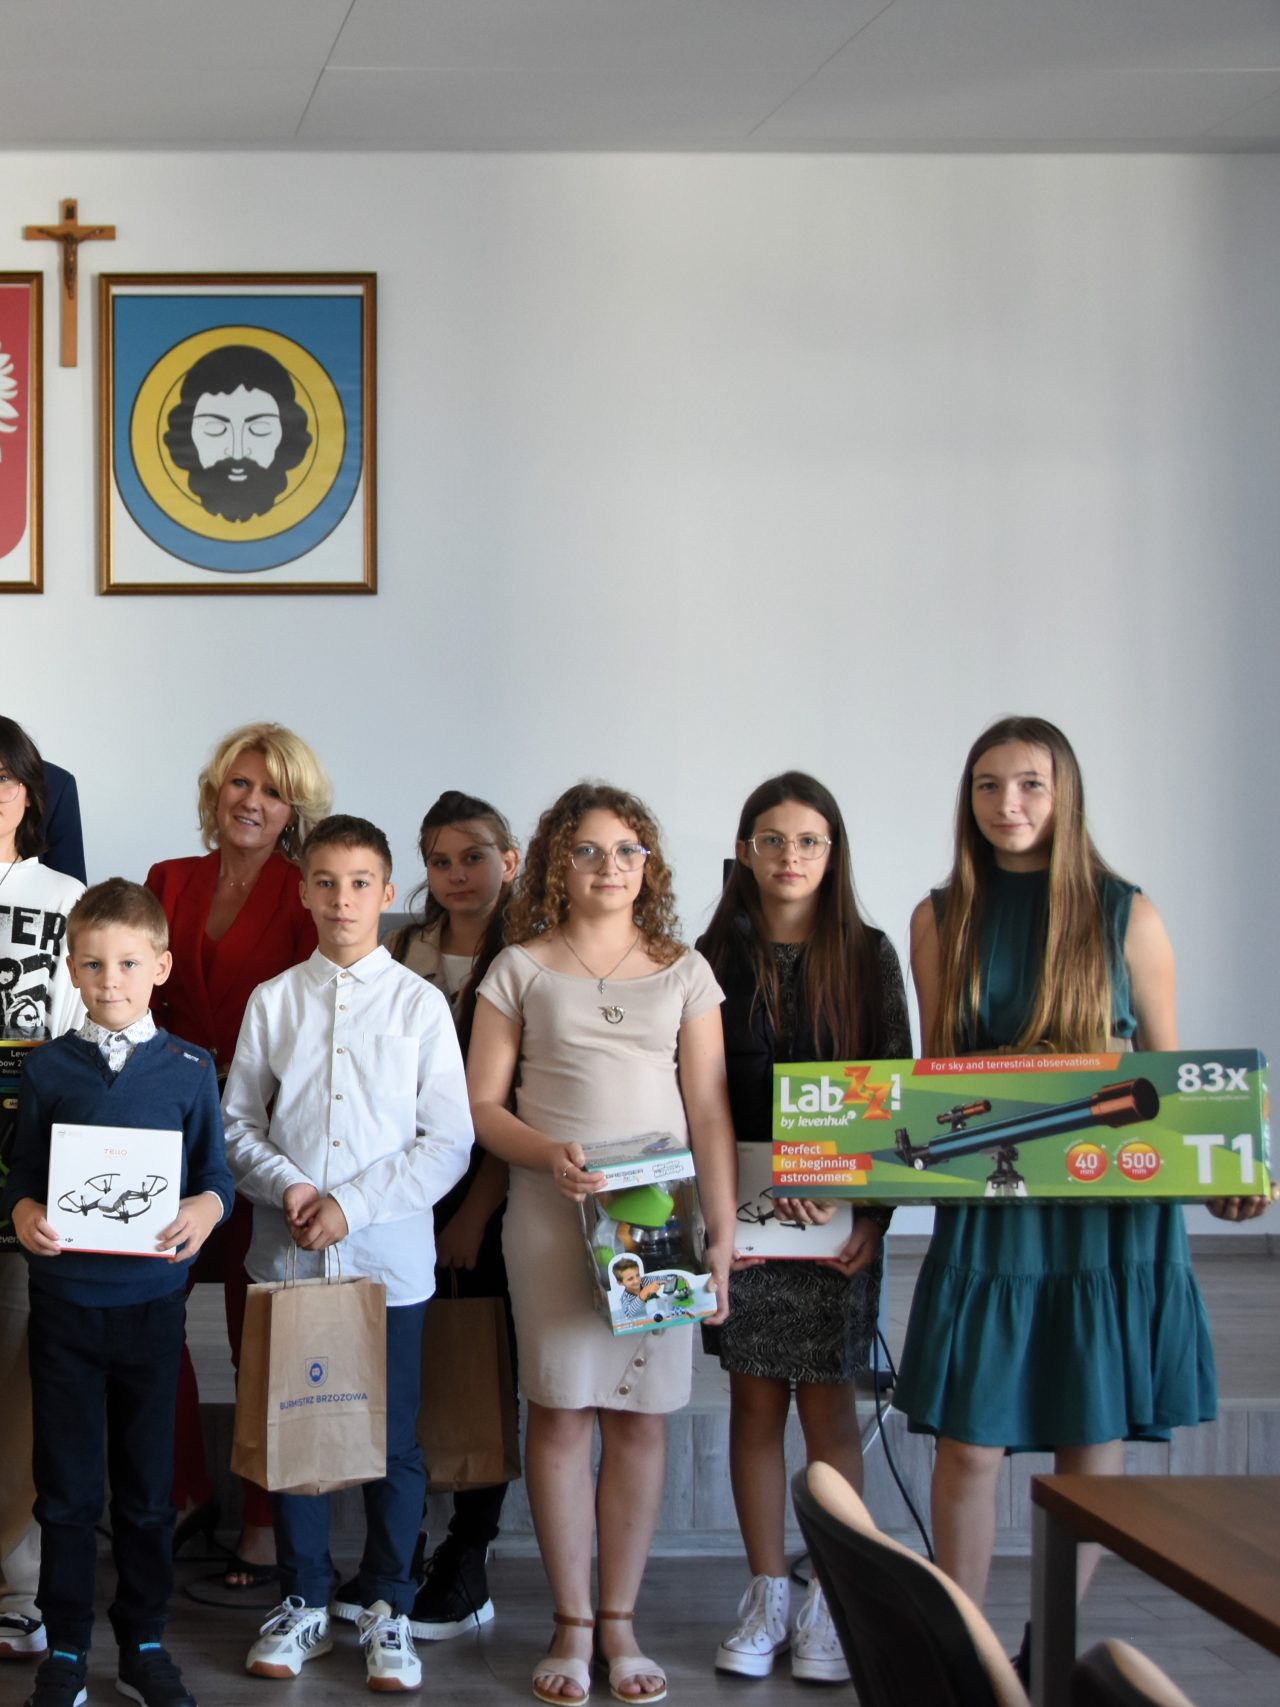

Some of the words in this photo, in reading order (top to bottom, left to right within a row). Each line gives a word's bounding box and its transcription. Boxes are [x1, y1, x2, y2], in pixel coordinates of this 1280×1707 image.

[931, 1062, 945, 1071] For
[948, 1061, 963, 1072] sky
[966, 1060, 984, 1070] and
[986, 1058, 1034, 1069] terrestrial
[1037, 1057, 1100, 1068] observations
[1177, 1061, 1250, 1093] 83x
[781, 1116, 794, 1129] by
[798, 1113, 849, 1127] levenhuk
[781, 1144, 821, 1154] Perfect
[781, 1157, 798, 1168] for
[800, 1157, 857, 1171] beginning
[1075, 1153, 1098, 1169] 40
[1121, 1152, 1156, 1169] 500
[1183, 1134, 1255, 1185] T1
[780, 1171, 853, 1183] astronomers
[280, 1396, 314, 1410] BURMISTRZ
[316, 1392, 368, 1404] BRZOZOWA
